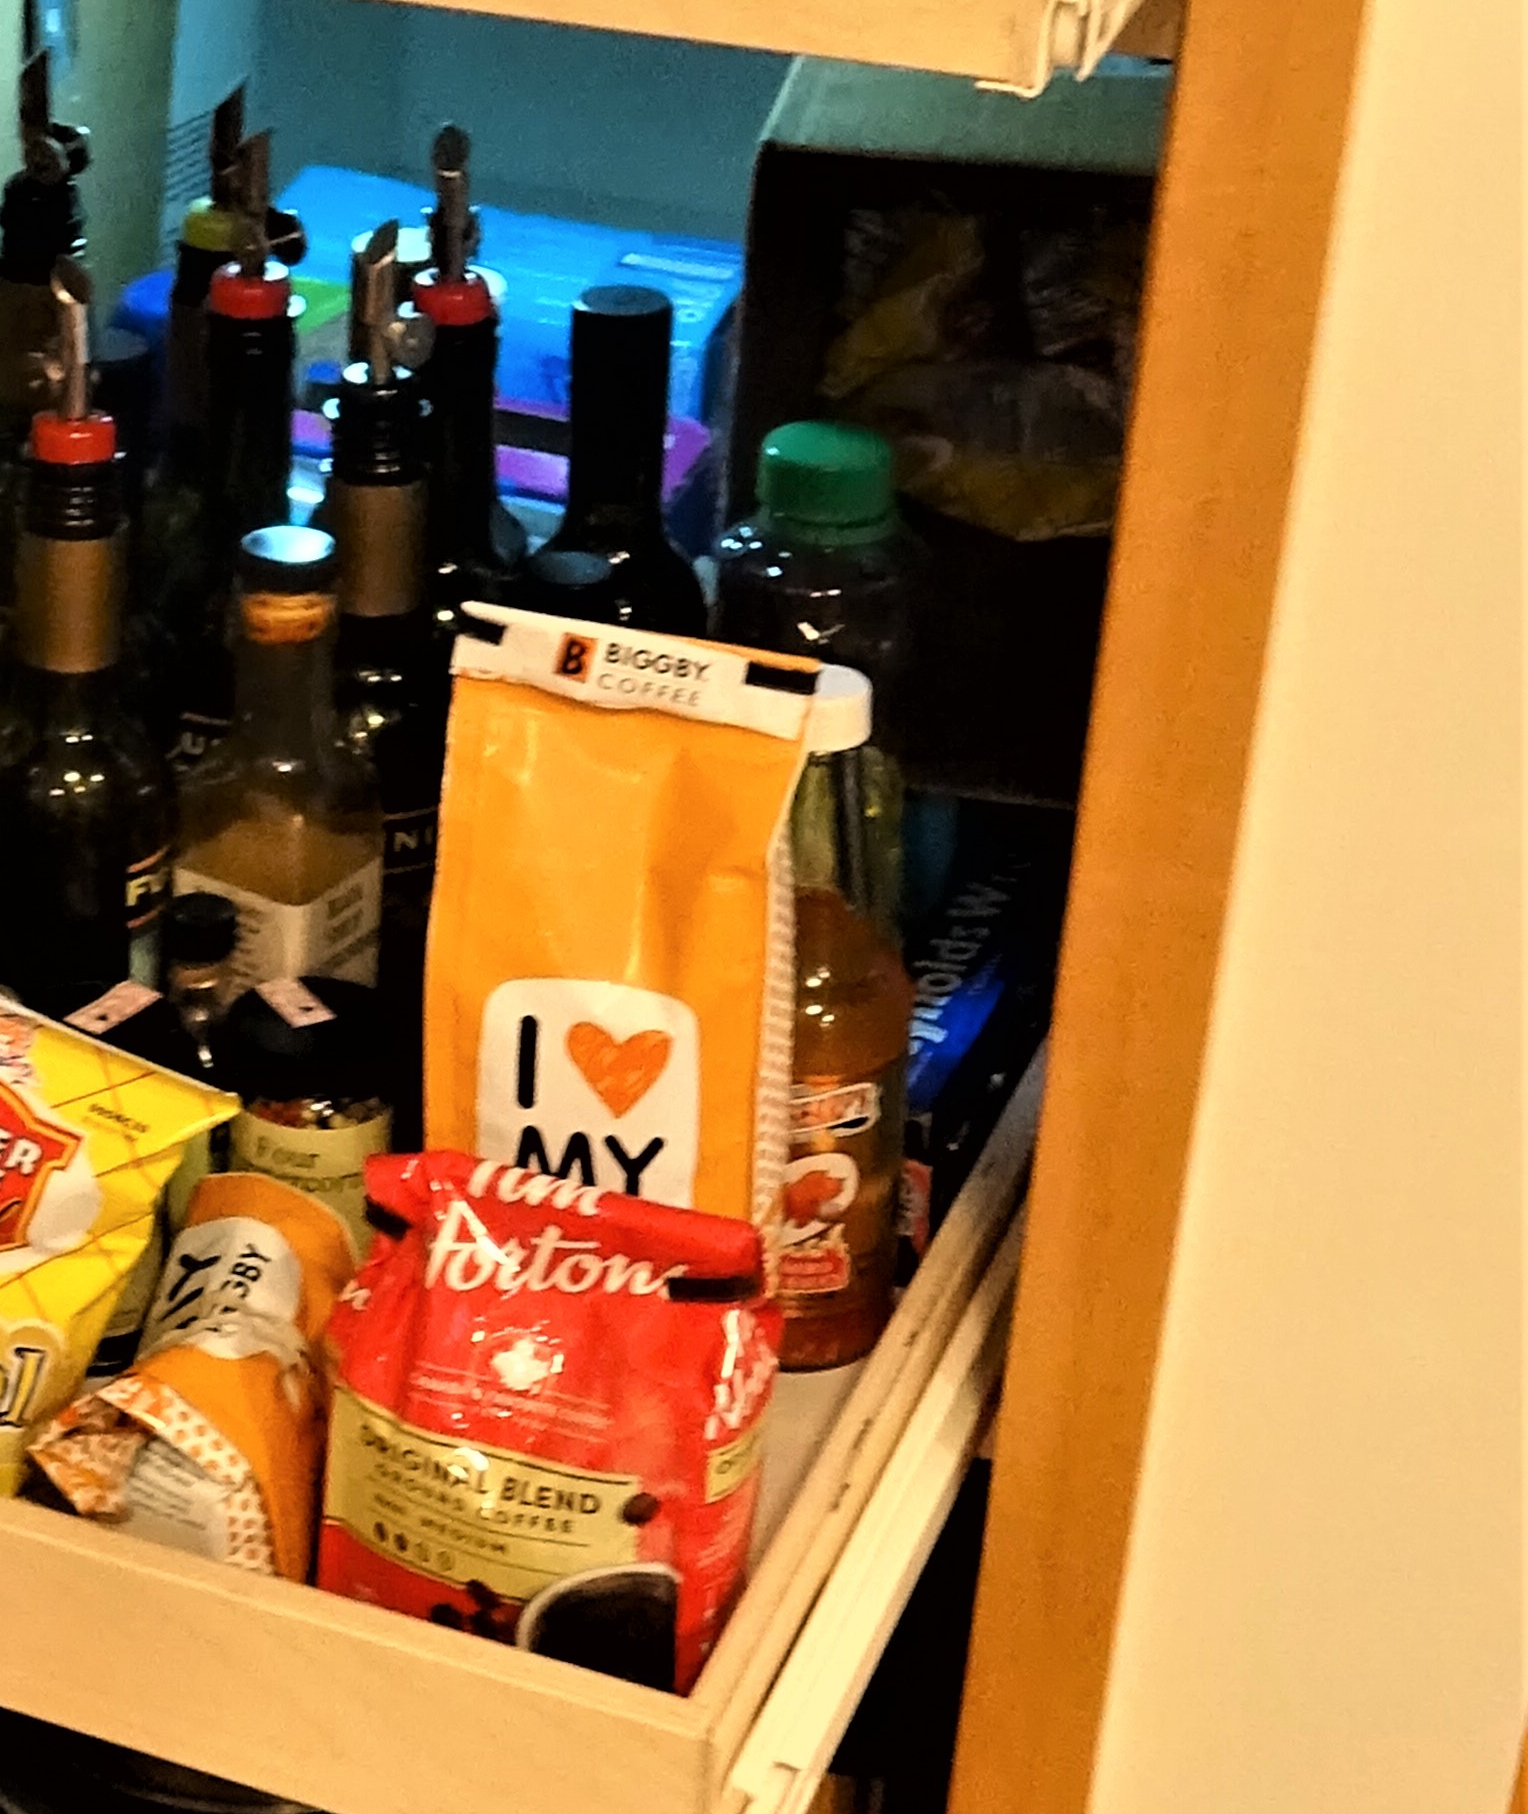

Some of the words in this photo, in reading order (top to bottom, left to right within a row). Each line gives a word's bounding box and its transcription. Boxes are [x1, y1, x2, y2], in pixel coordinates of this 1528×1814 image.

[560, 639, 586, 676] B
[605, 642, 713, 681] BIGGBY
[597, 672, 701, 707] COFFEE
[515, 1014, 539, 1110] I
[514, 1124, 666, 1195] MY
[500, 1475, 600, 1516] BLEND
